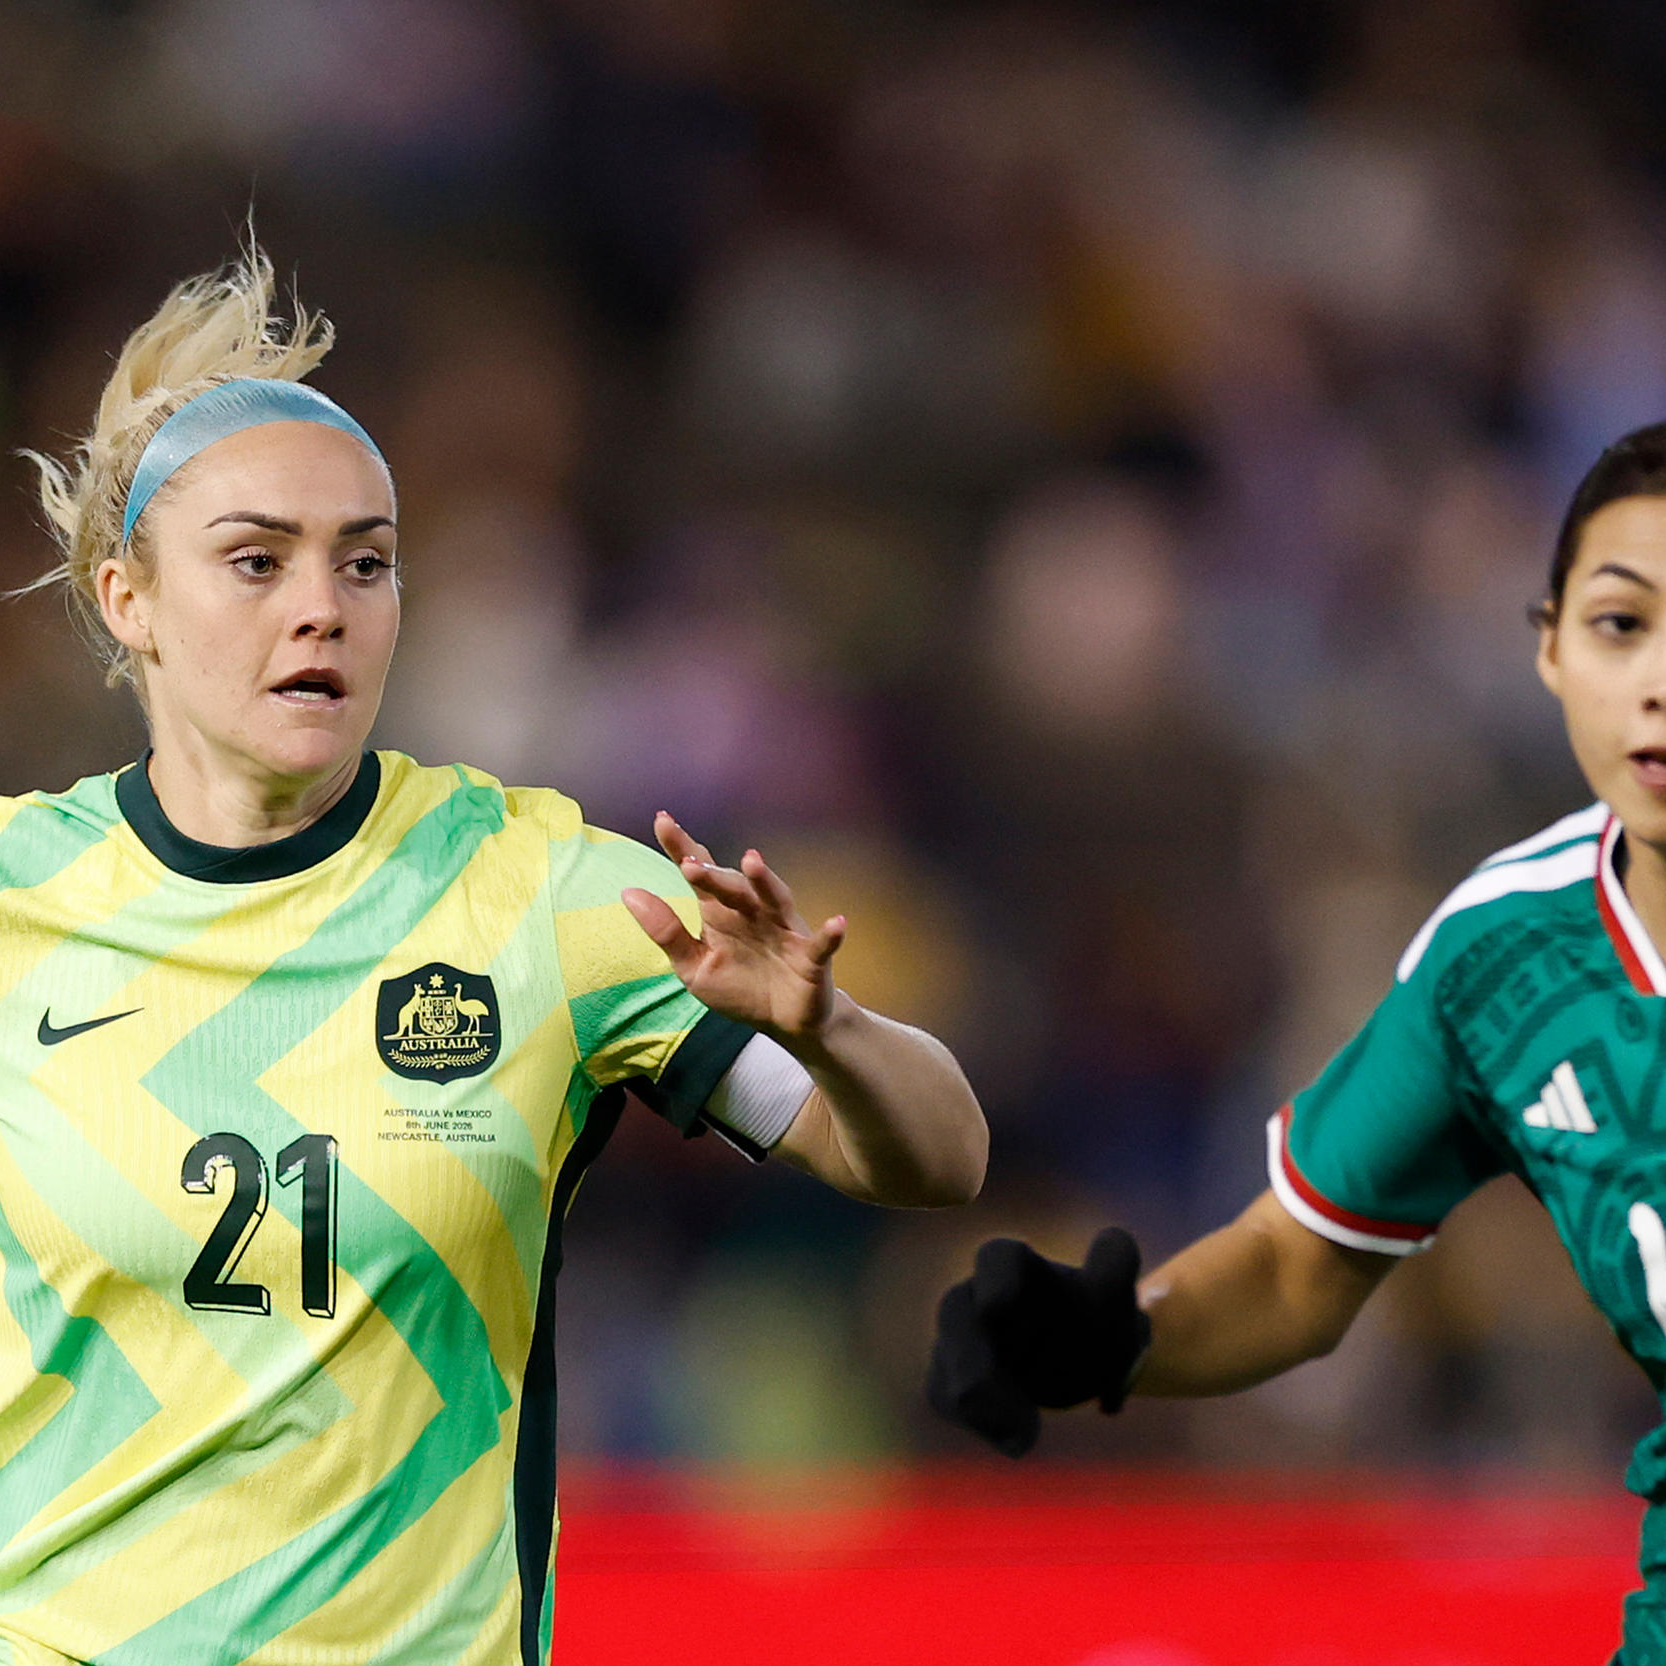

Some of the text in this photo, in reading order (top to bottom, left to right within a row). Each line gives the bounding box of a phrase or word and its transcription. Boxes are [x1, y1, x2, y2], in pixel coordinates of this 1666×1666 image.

[399, 1037, 480, 1051] AUSTRALIA
[384, 1108, 440, 1118] AUSTRALIA
[456, 1110, 492, 1119] MEXICO
[424, 1121, 450, 1130] JUNE
[446, 1134, 496, 1142] AUSTRALIA
[181, 1132, 339, 1319] 21
